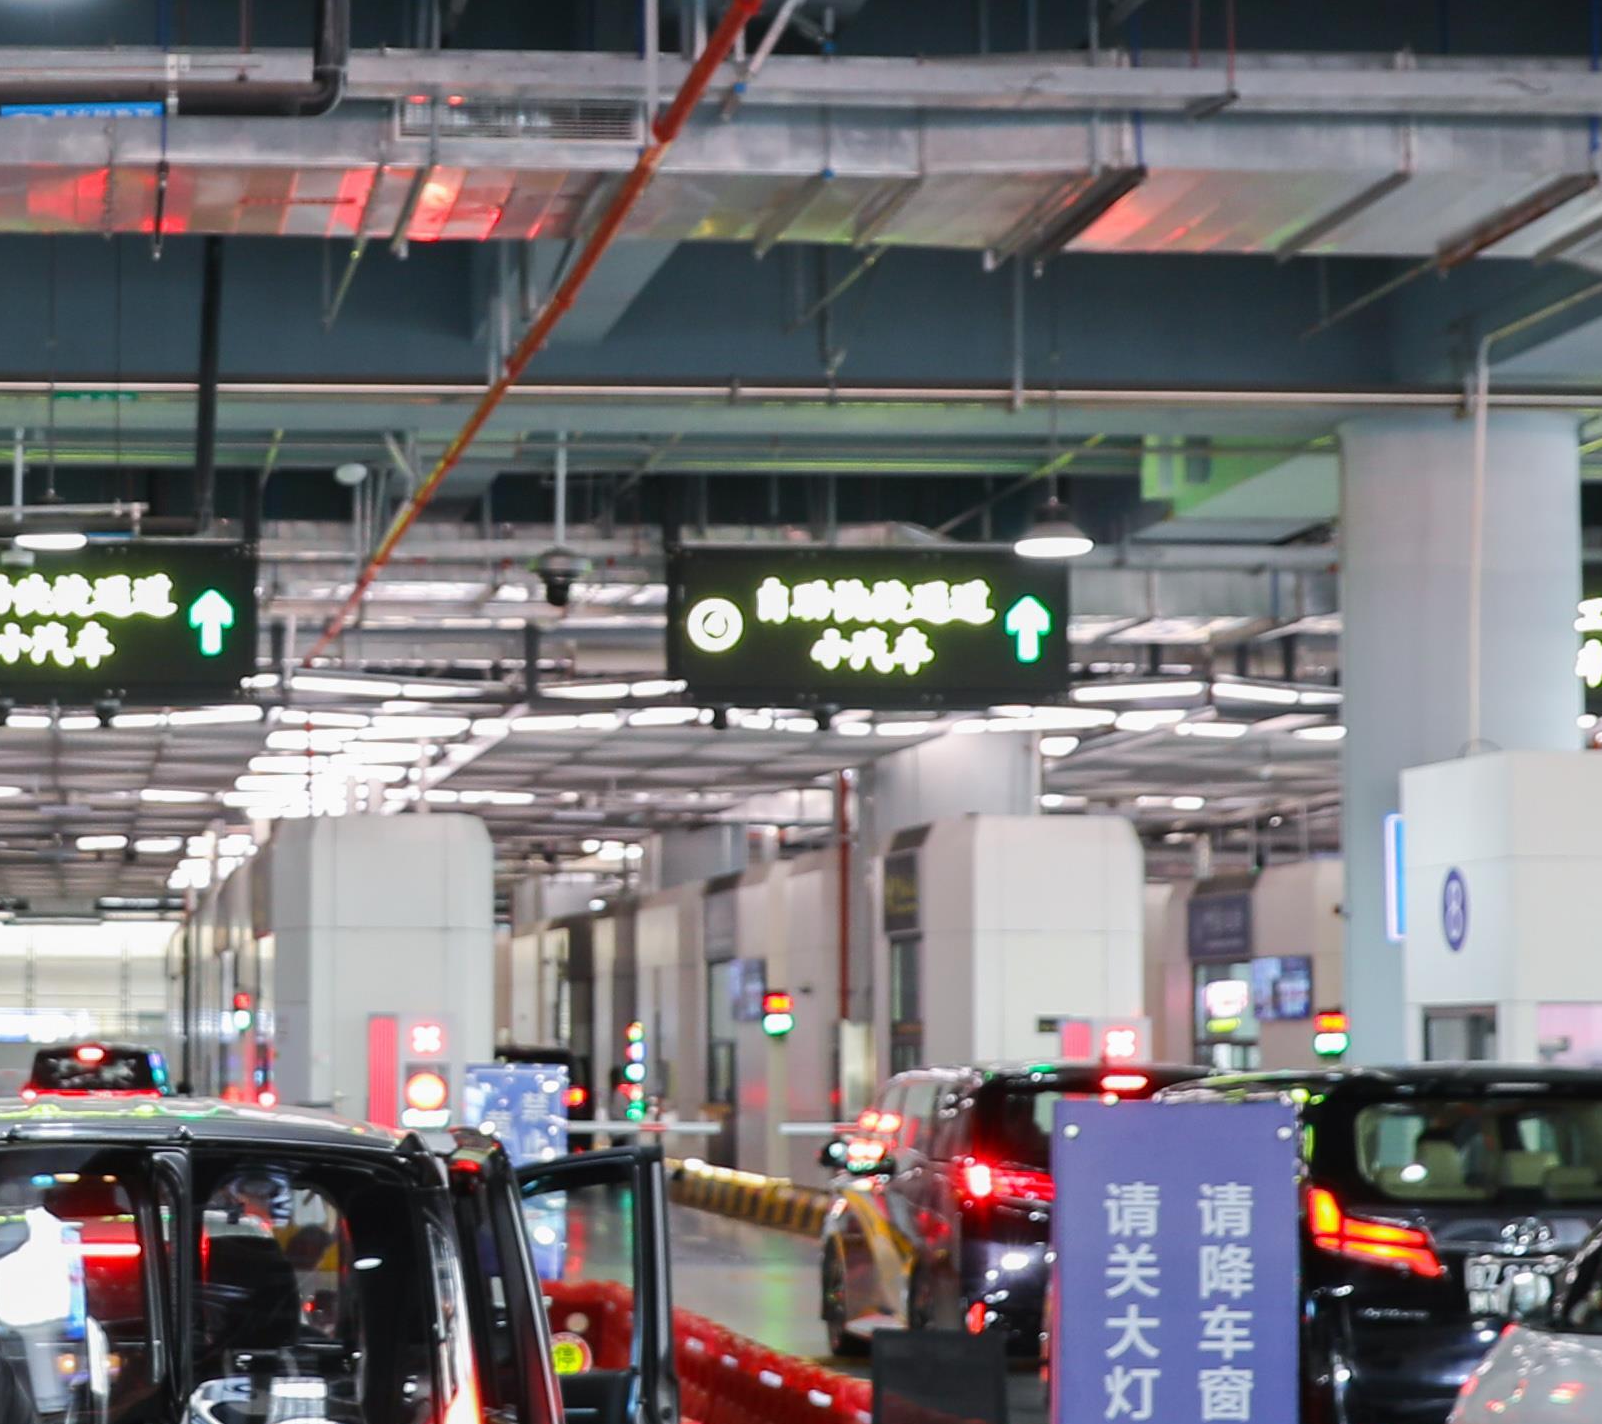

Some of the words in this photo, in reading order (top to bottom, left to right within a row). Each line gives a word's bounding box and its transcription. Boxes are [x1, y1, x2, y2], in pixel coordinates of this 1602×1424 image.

[1104, 1183, 1161, 1423] 请关大灯
[1198, 1183, 1254, 1423] 请降车窗
